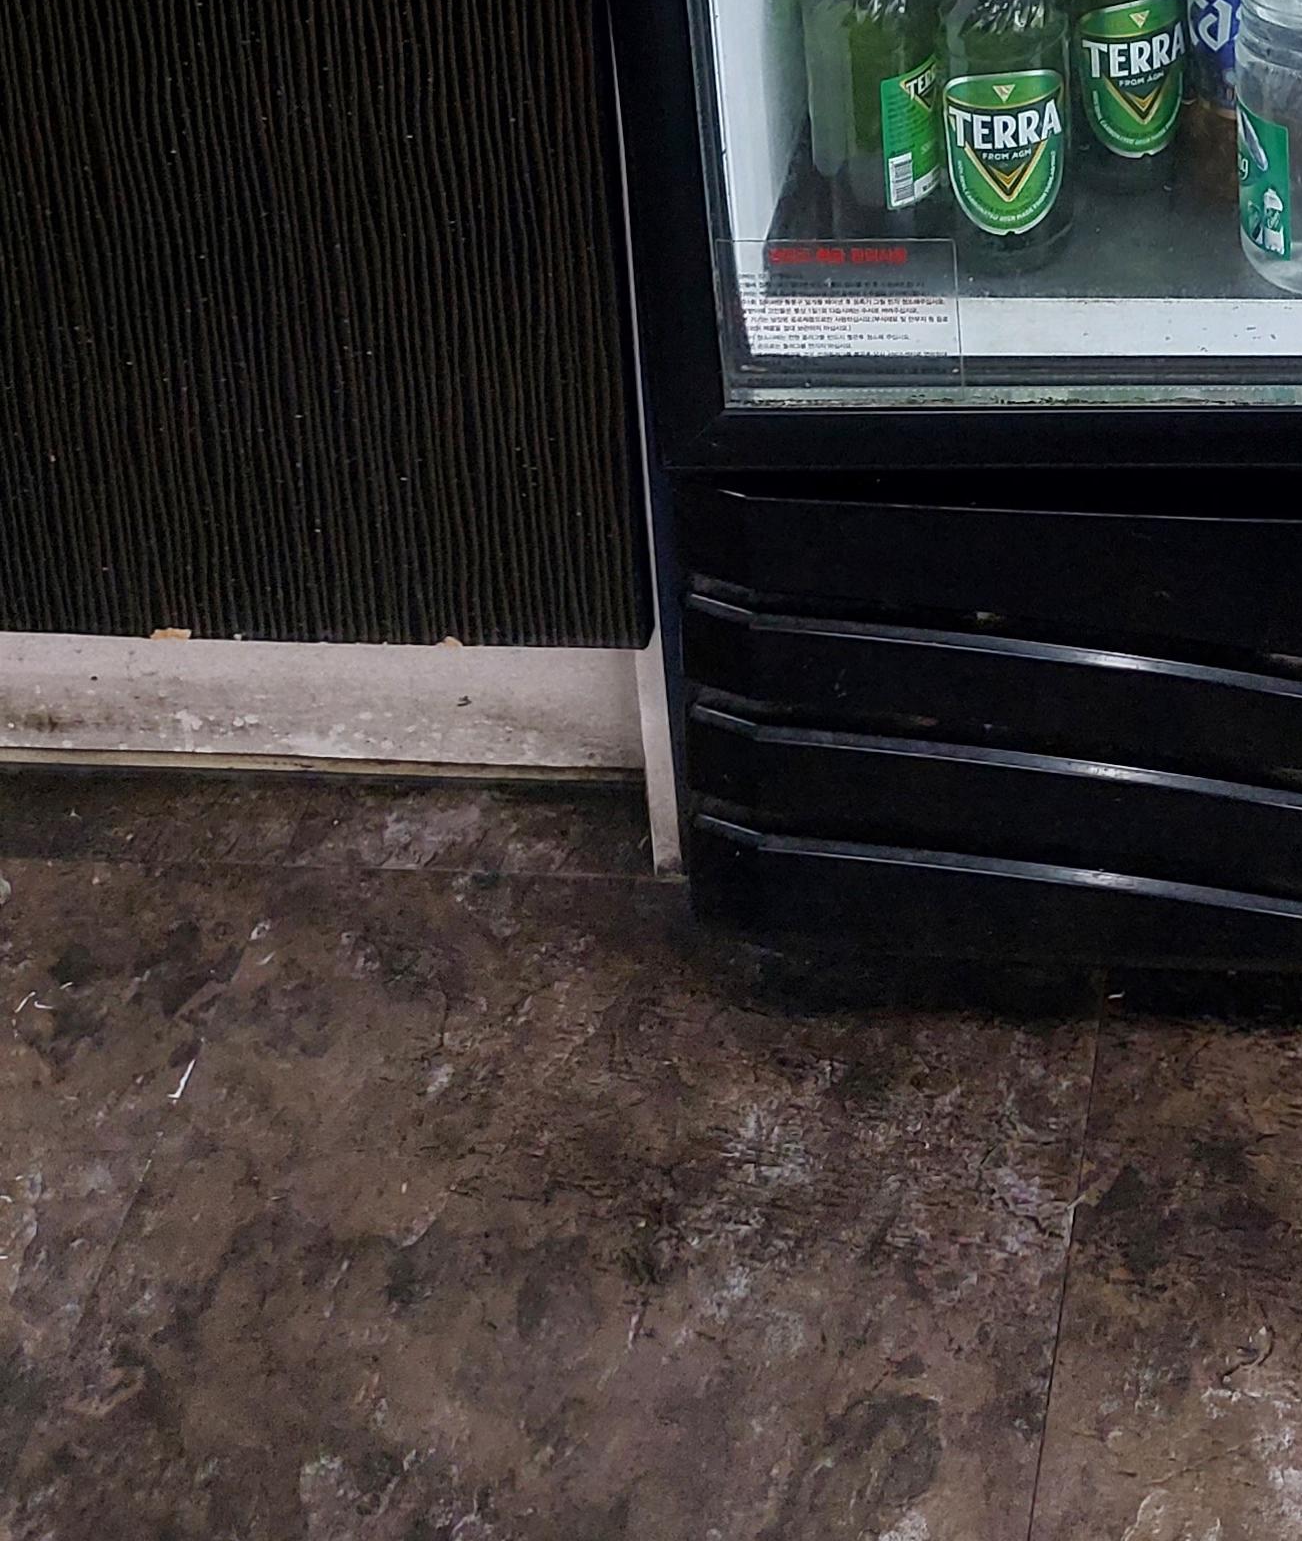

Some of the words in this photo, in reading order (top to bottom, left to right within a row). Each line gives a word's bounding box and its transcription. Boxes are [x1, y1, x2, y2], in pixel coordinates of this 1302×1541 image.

[1082, 20, 1187, 79] TERRA
[949, 98, 1063, 151] TERRA
[982, 152, 1011, 161] FROM
